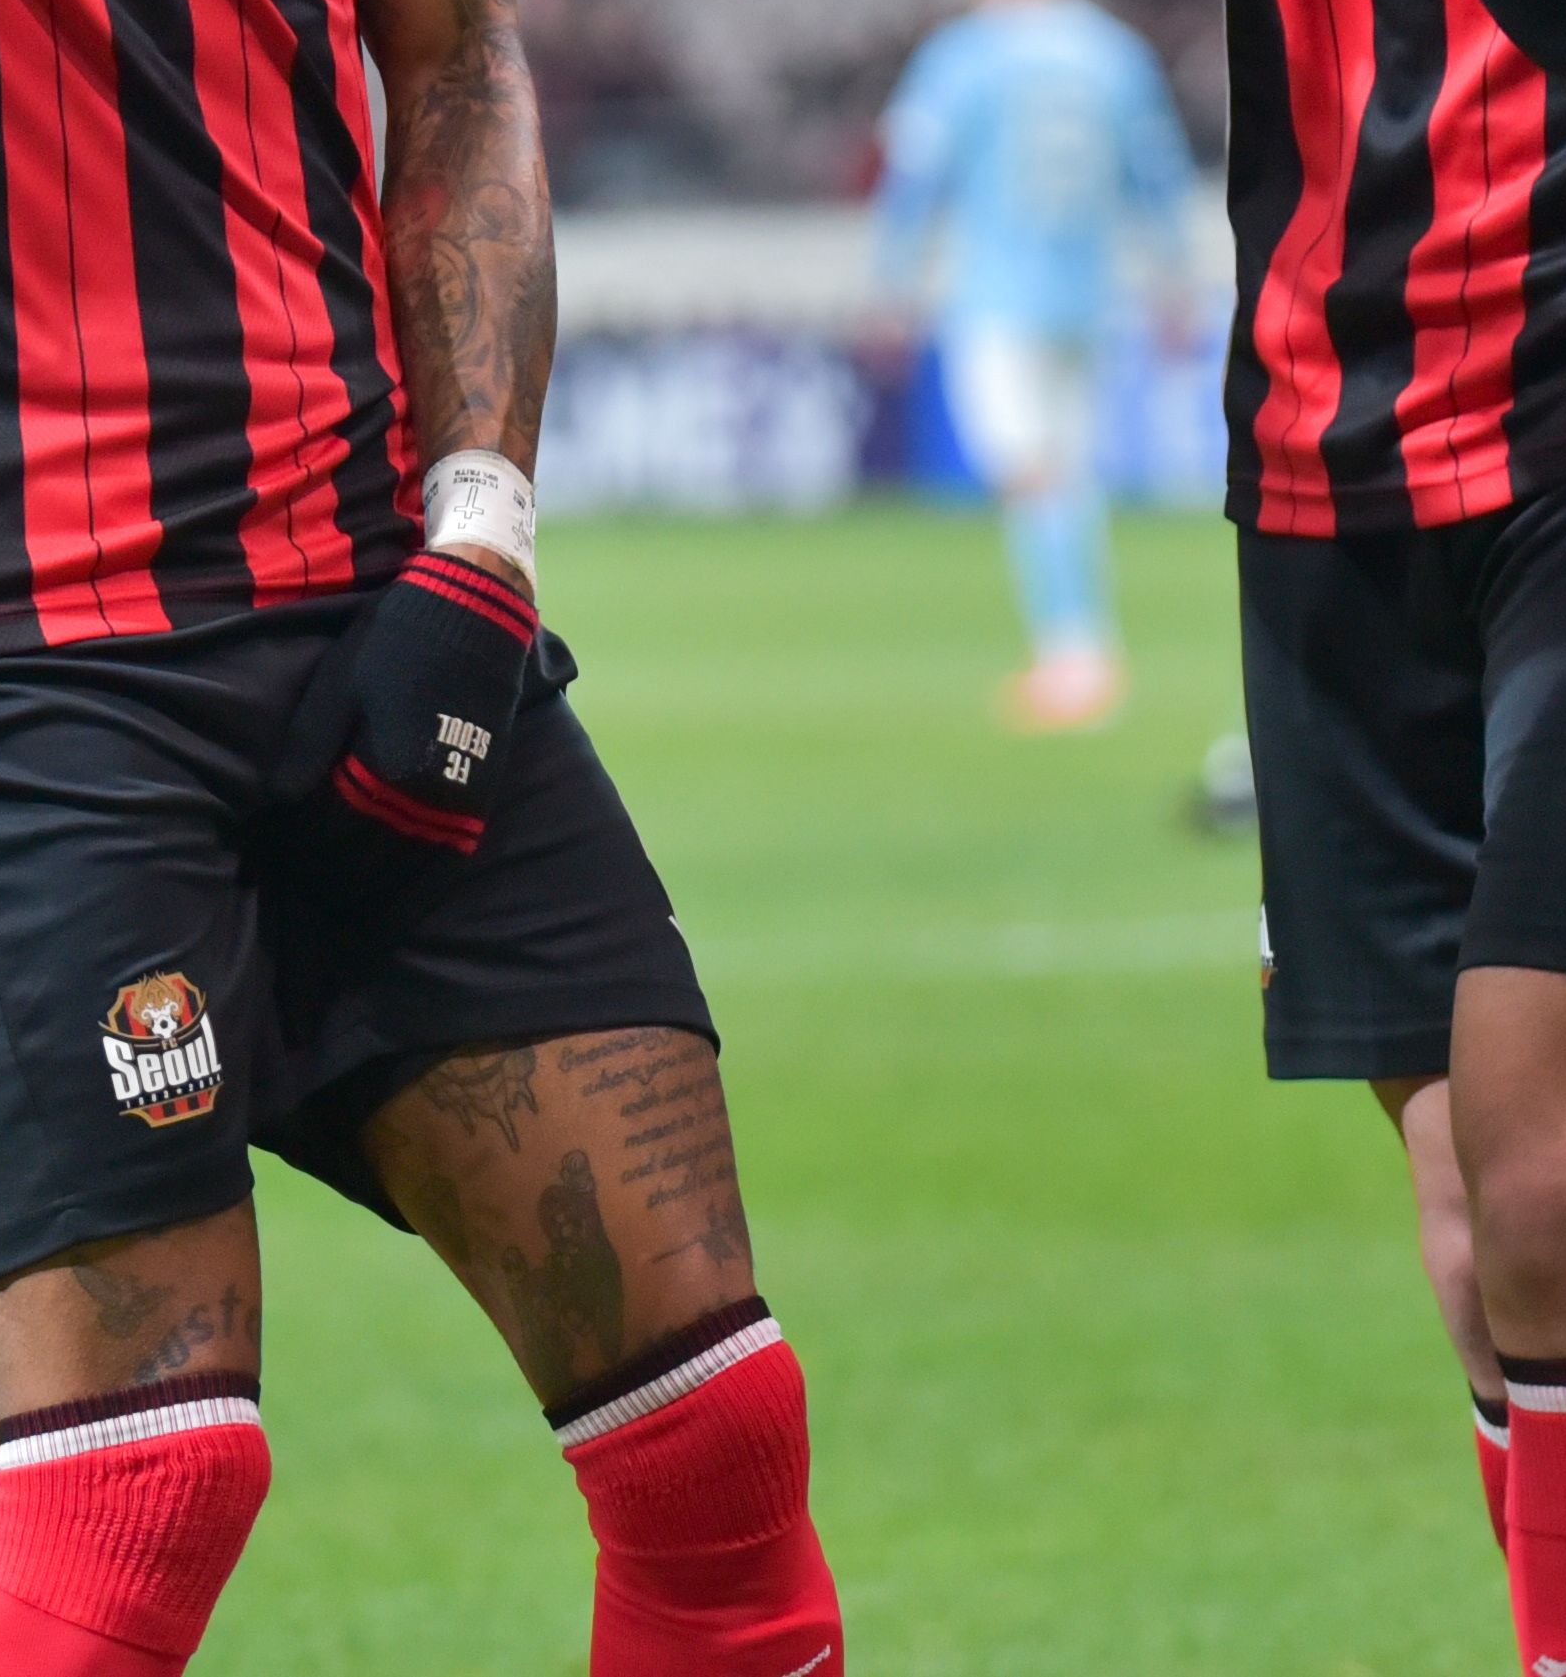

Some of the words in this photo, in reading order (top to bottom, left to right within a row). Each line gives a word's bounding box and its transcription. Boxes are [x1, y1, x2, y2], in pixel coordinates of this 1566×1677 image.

[436, 712, 492, 761] SEOUL
[443, 750, 471, 785] FC
[102, 1011, 222, 1101] Seoul
